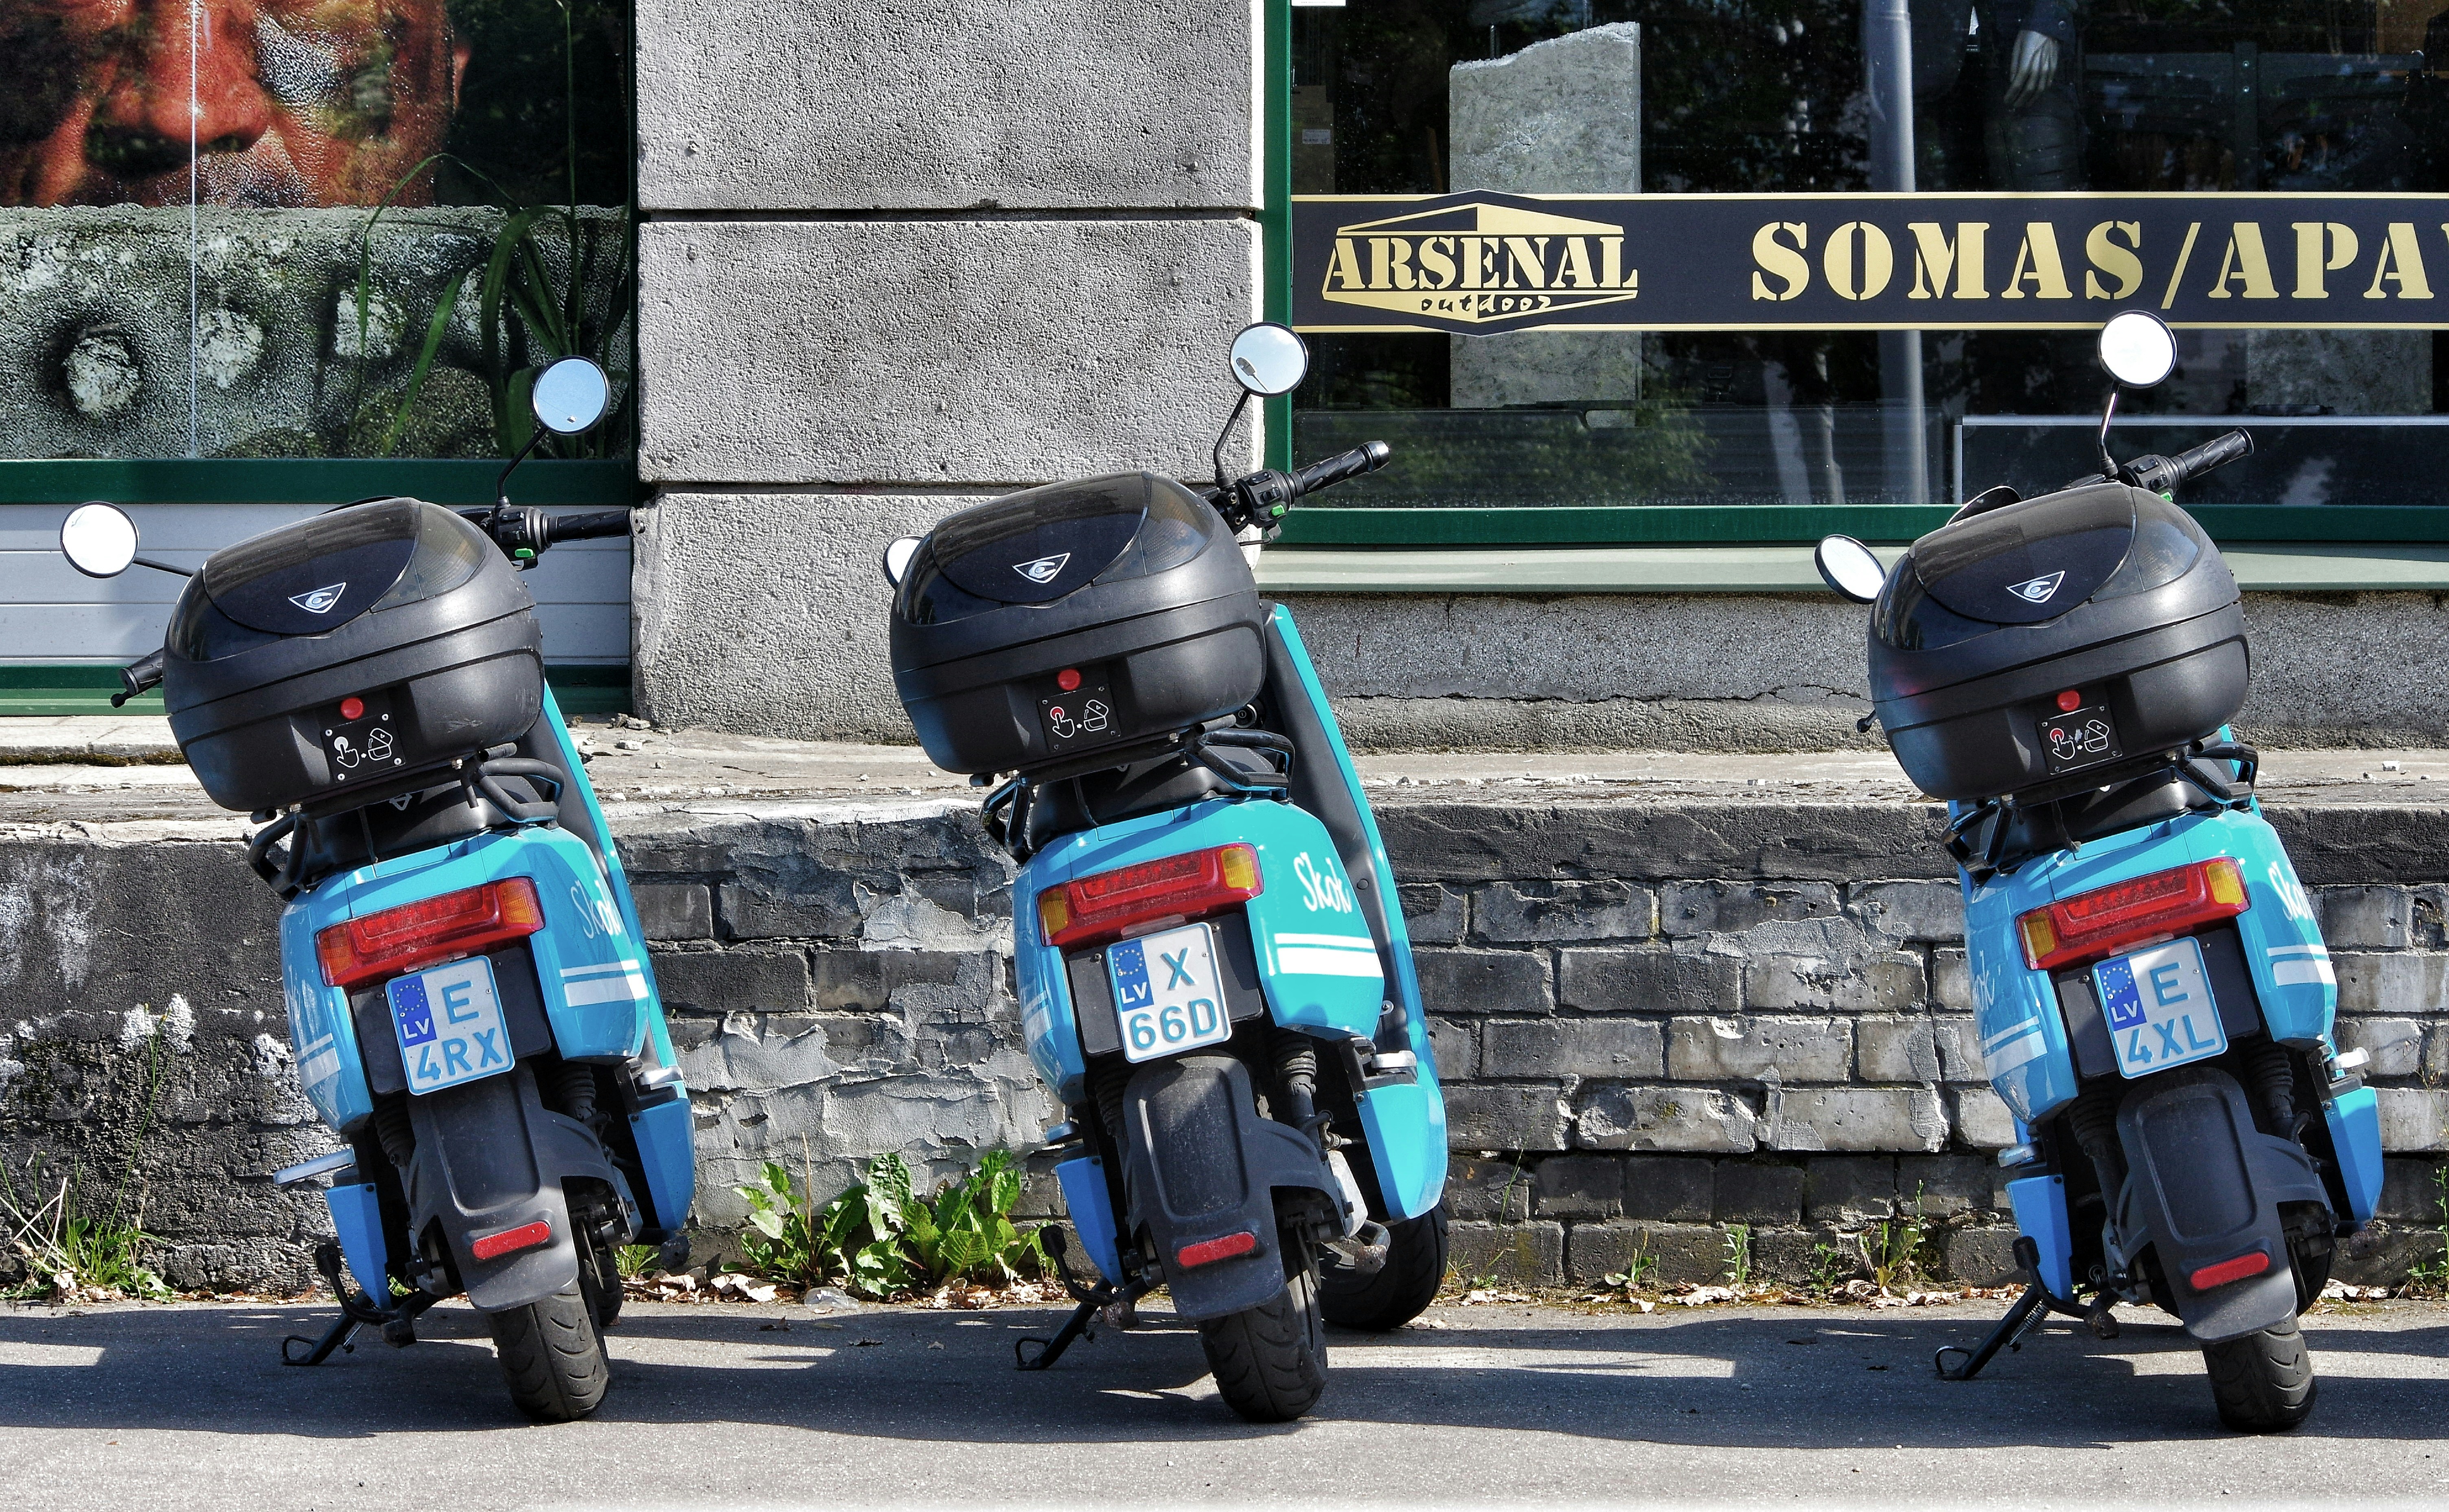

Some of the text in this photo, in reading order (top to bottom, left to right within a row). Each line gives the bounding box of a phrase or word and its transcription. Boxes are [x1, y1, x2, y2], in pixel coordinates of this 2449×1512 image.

[1325, 236, 1639, 290] ARSENAL
[1752, 221, 2449, 309] SOMAS/APA
[1420, 294, 1553, 314] outdoor
[1159, 946, 1198, 991] X
[2149, 961, 2190, 1007] E
[441, 980, 481, 1025] E
[1119, 981, 1147, 1004] LV
[2110, 1000, 2138, 1023] LV
[402, 1017, 429, 1040] LV
[1129, 997, 1219, 1050] 66D
[2128, 1015, 2217, 1064] 4XL
[417, 1027, 504, 1080] 4RX
